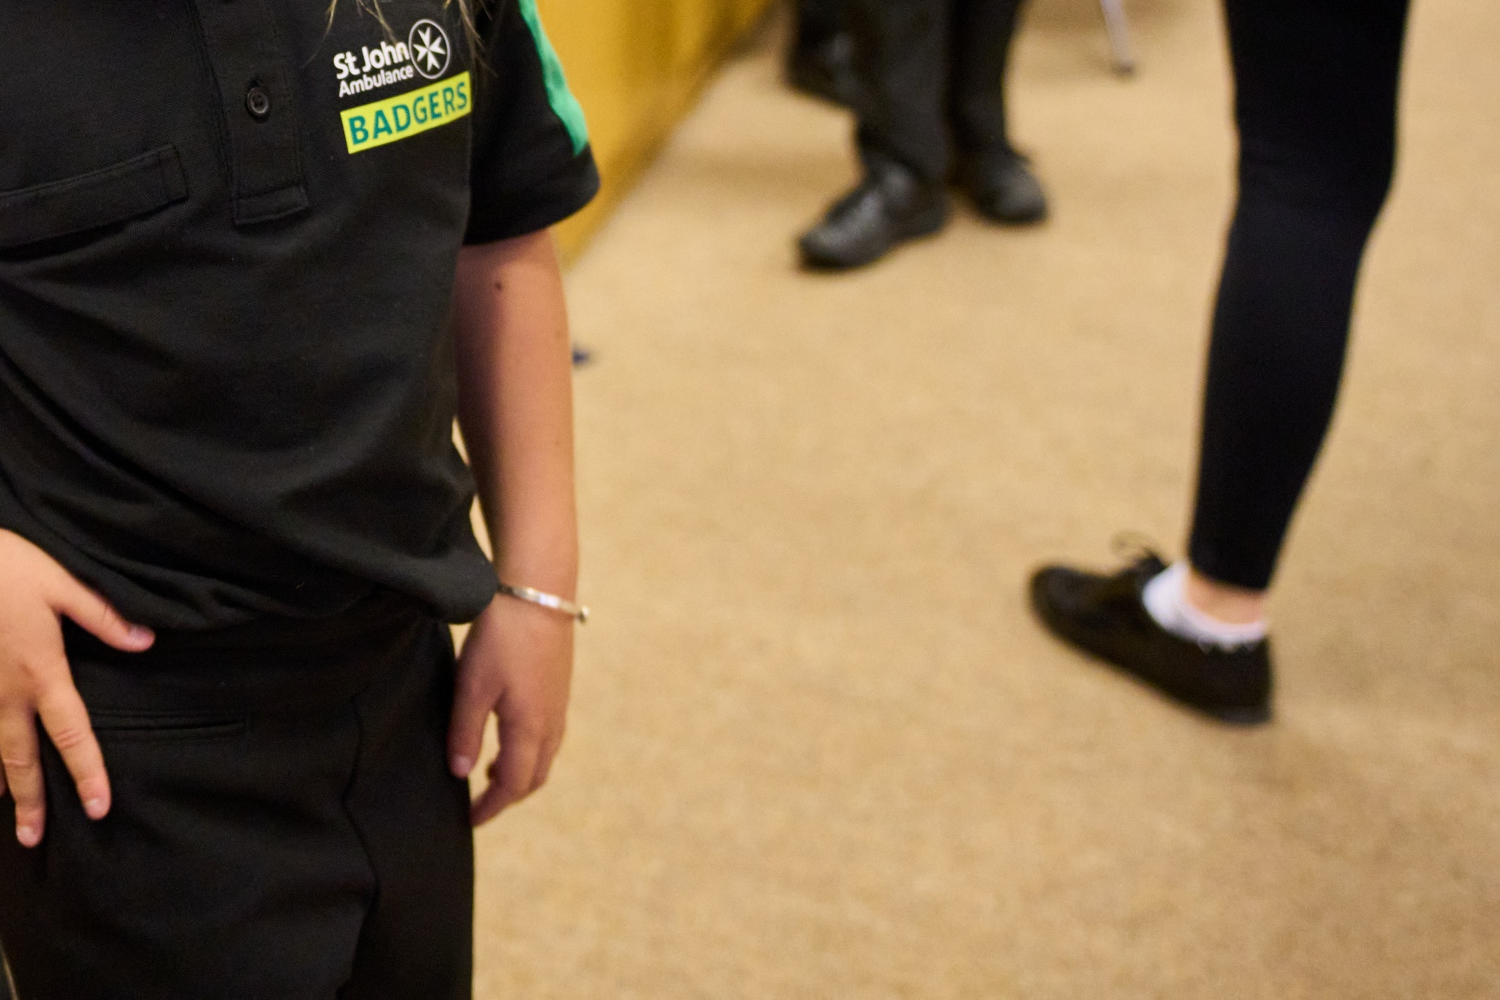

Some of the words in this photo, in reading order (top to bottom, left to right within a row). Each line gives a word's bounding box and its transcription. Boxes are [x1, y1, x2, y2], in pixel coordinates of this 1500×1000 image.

[333, 51, 361, 80] St
[361, 41, 410, 73] John
[339, 64, 414, 98] Ambulance
[348, 81, 468, 145] BADGERS
